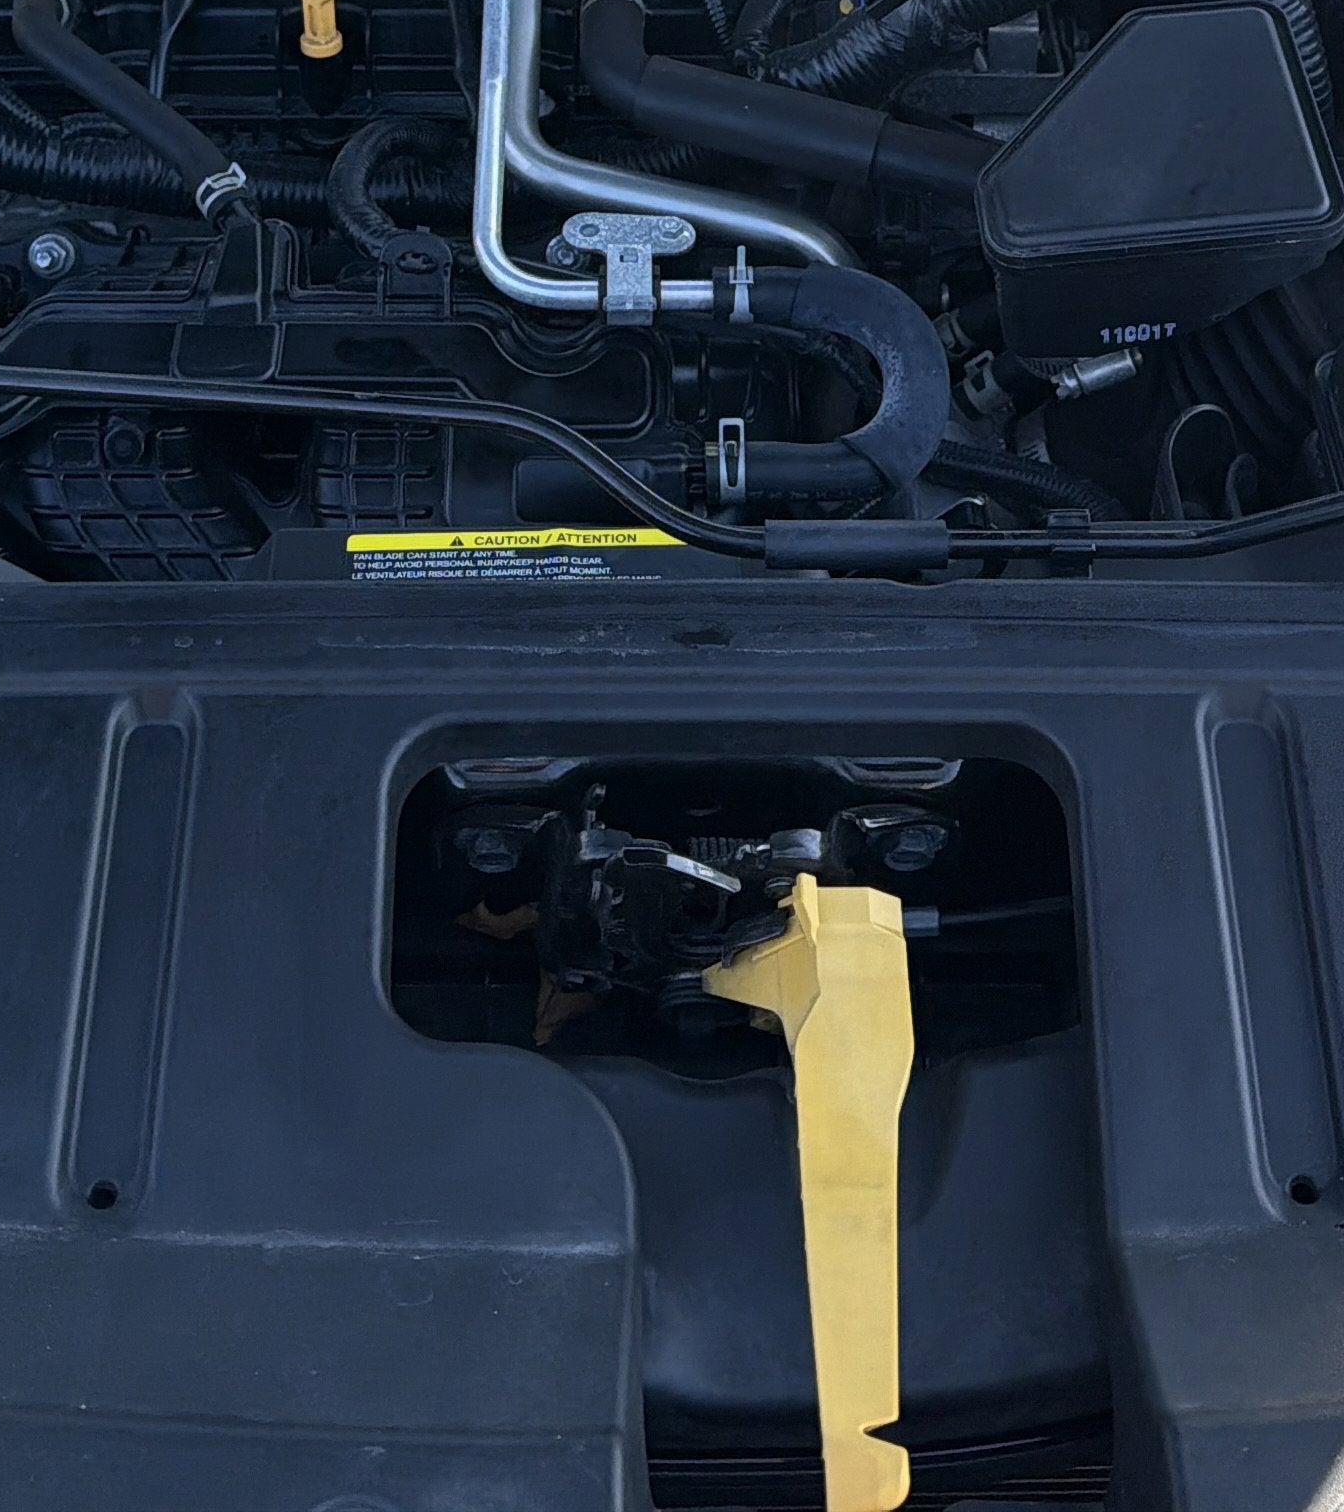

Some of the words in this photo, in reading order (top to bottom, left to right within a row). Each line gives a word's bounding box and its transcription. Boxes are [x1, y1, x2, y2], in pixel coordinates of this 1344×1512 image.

[474, 535, 540, 545] CAUTION
[557, 533, 637, 544] ATTENTION
[374, 552, 405, 560] BLADE
[406, 551, 428, 559] CAN
[428, 551, 459, 559] START
[459, 550, 472, 558] AT
[472, 550, 494, 558] ANY
[353, 561, 366, 569] TO
[367, 561, 393, 569] HELP
[393, 560, 423, 568] AVOID
[424, 559, 476, 568] PERSONAL
[535, 555, 569, 565] HANDS
[351, 572, 364, 580] LE
[365, 570, 427, 579] VENTILATEUR
[427, 569, 464, 578] RISQUE
[465, 569, 479, 577] DE
[480, 567, 533, 576] DÉMARRER
[542, 565, 569, 574] TOUT
